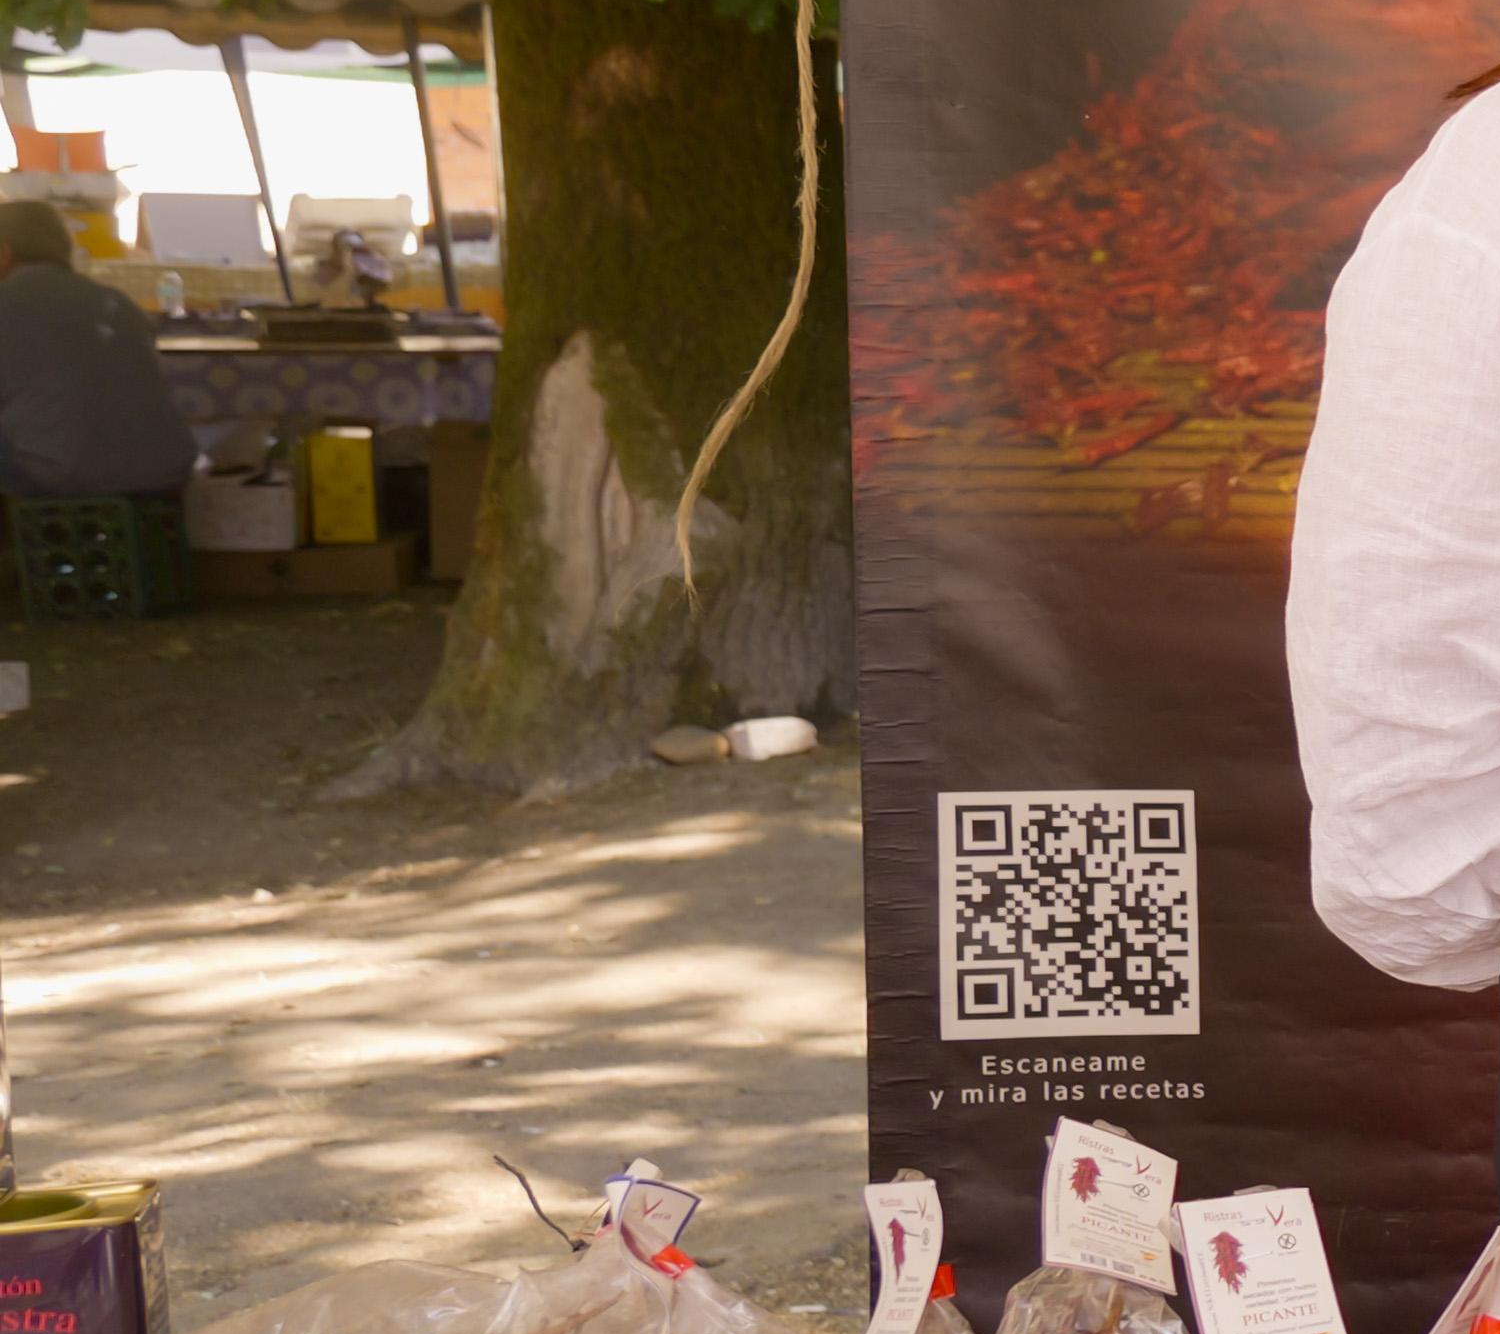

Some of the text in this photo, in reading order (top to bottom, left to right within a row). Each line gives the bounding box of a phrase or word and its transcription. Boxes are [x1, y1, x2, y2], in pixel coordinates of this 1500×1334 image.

[982, 1055, 1146, 1075] Escaneame
[930, 1080, 1205, 1110] y mira las recetas
[1243, 1303, 1318, 1326] PICANTE
